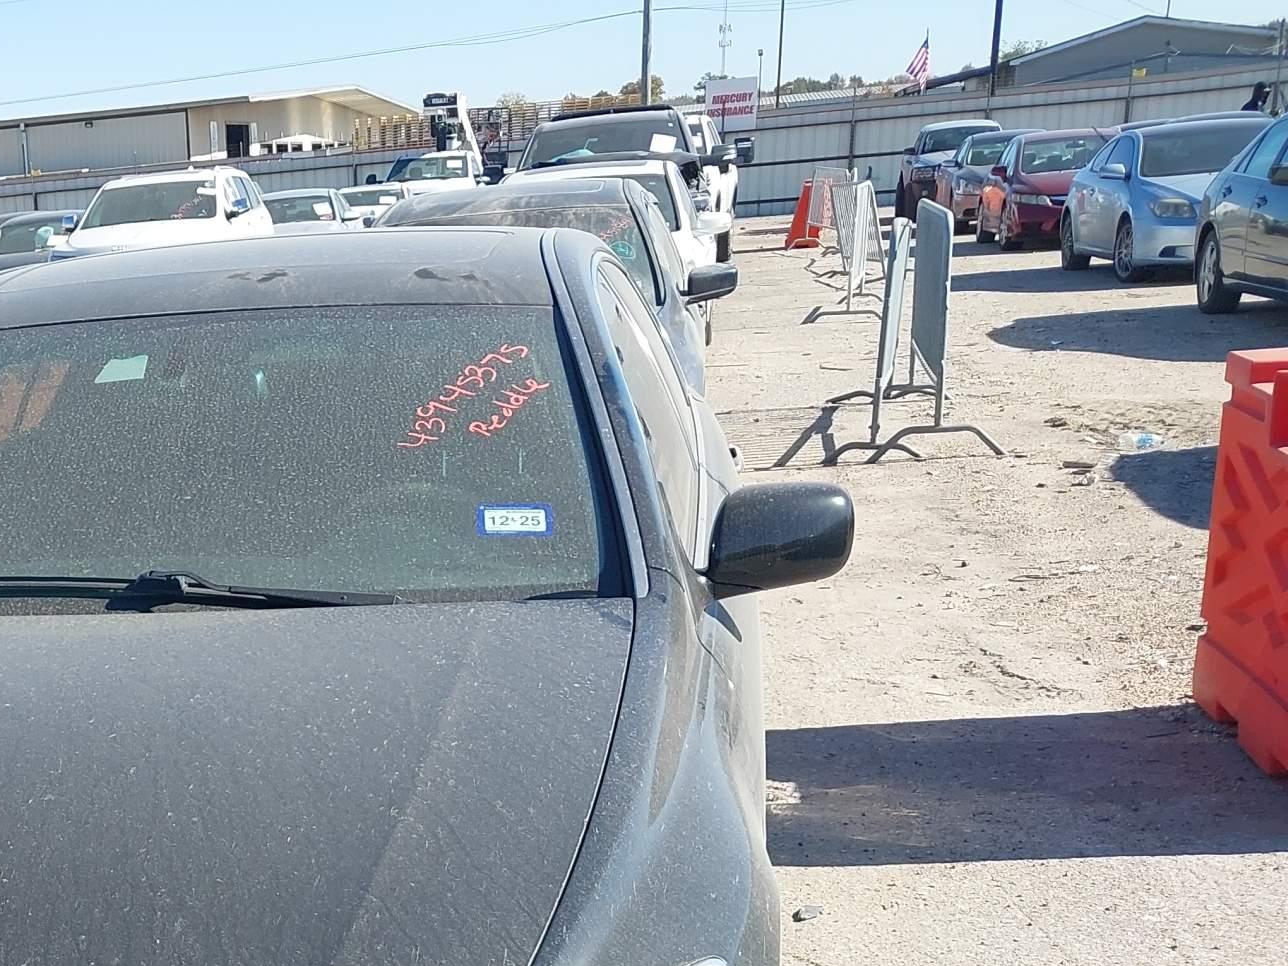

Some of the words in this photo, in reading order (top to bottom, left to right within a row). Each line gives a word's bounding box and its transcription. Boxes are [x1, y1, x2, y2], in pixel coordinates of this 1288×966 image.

[712, 92, 754, 105] MERCURY
[707, 105, 754, 118] INSURANCE
[397, 343, 529, 447] 43945375
